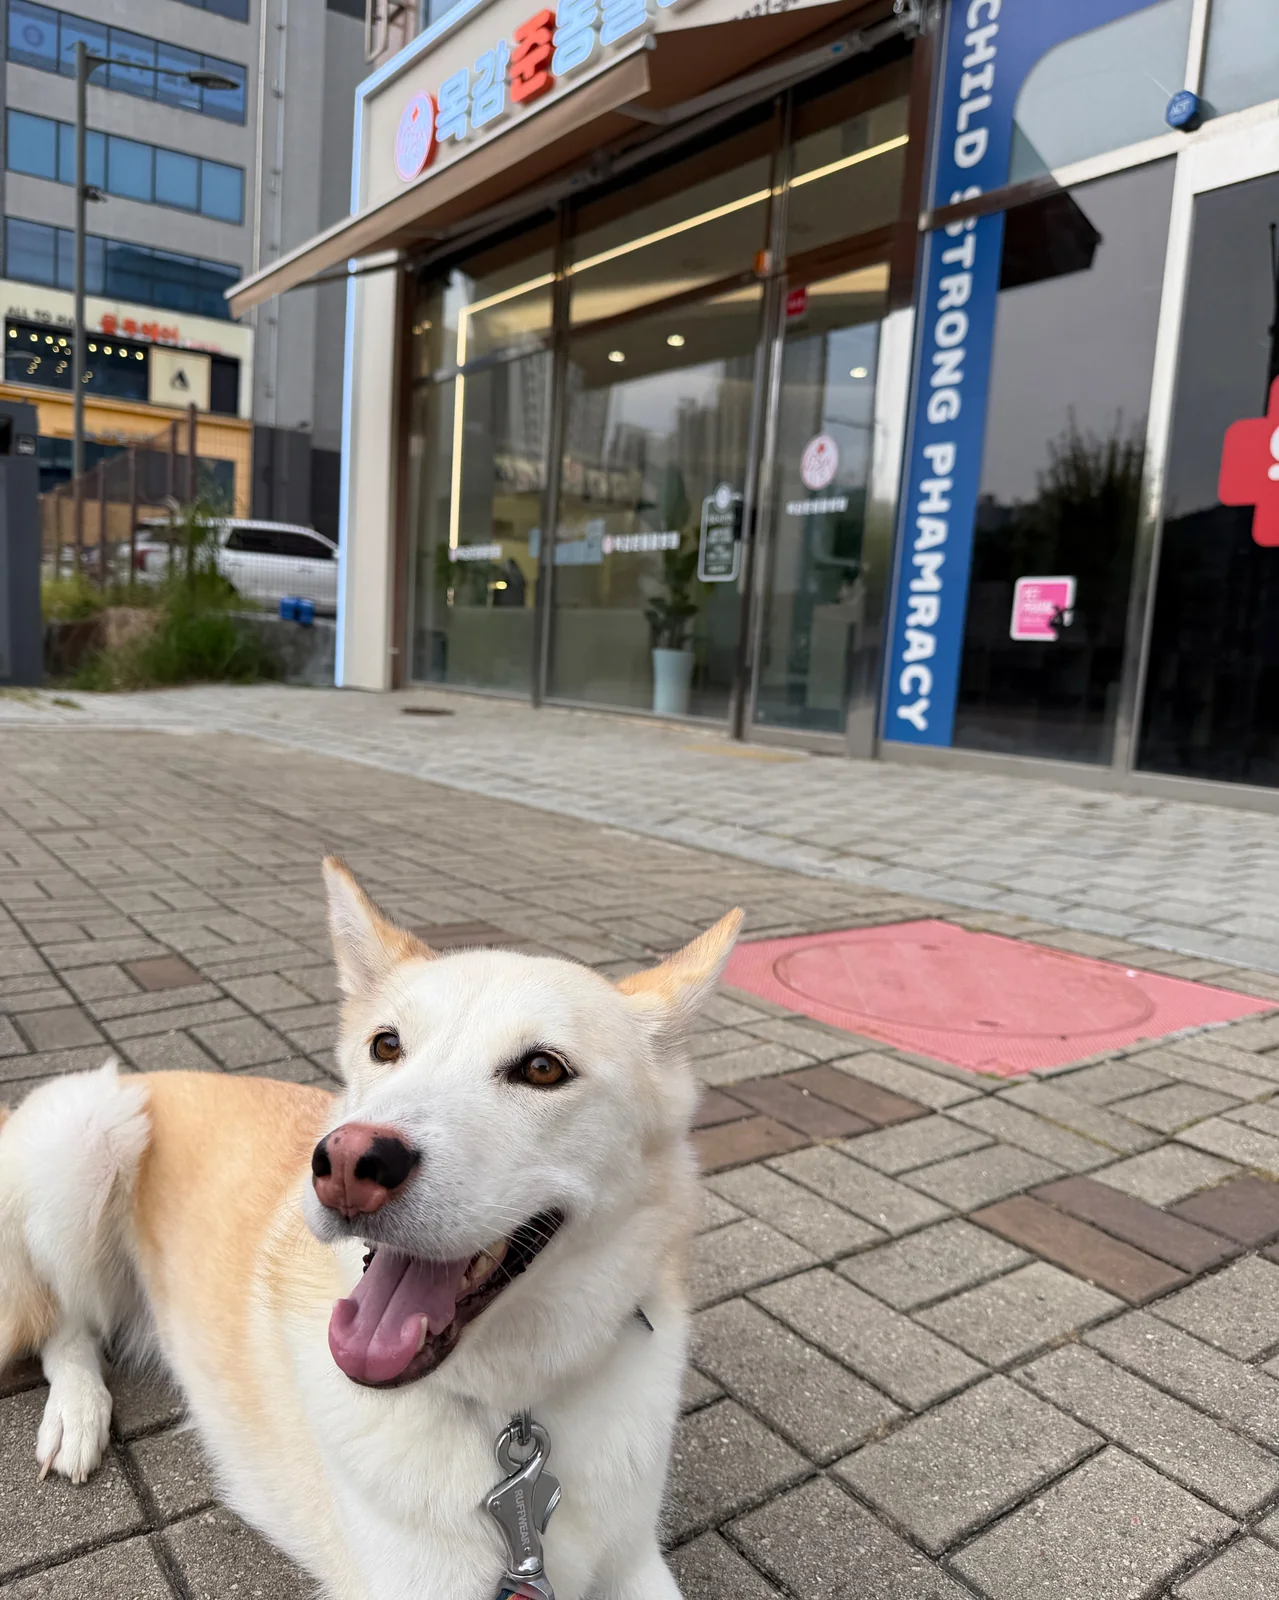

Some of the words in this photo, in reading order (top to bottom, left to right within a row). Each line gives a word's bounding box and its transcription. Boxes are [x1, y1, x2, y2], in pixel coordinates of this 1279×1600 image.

[435, 0, 677, 142] 목감준동
[953, 0, 1002, 169] CHILD
[925, 184, 983, 425] STRONG
[896, 440, 957, 732] PHAMRACY
[515, 1489, 530, 1546] RUFFWEAR
